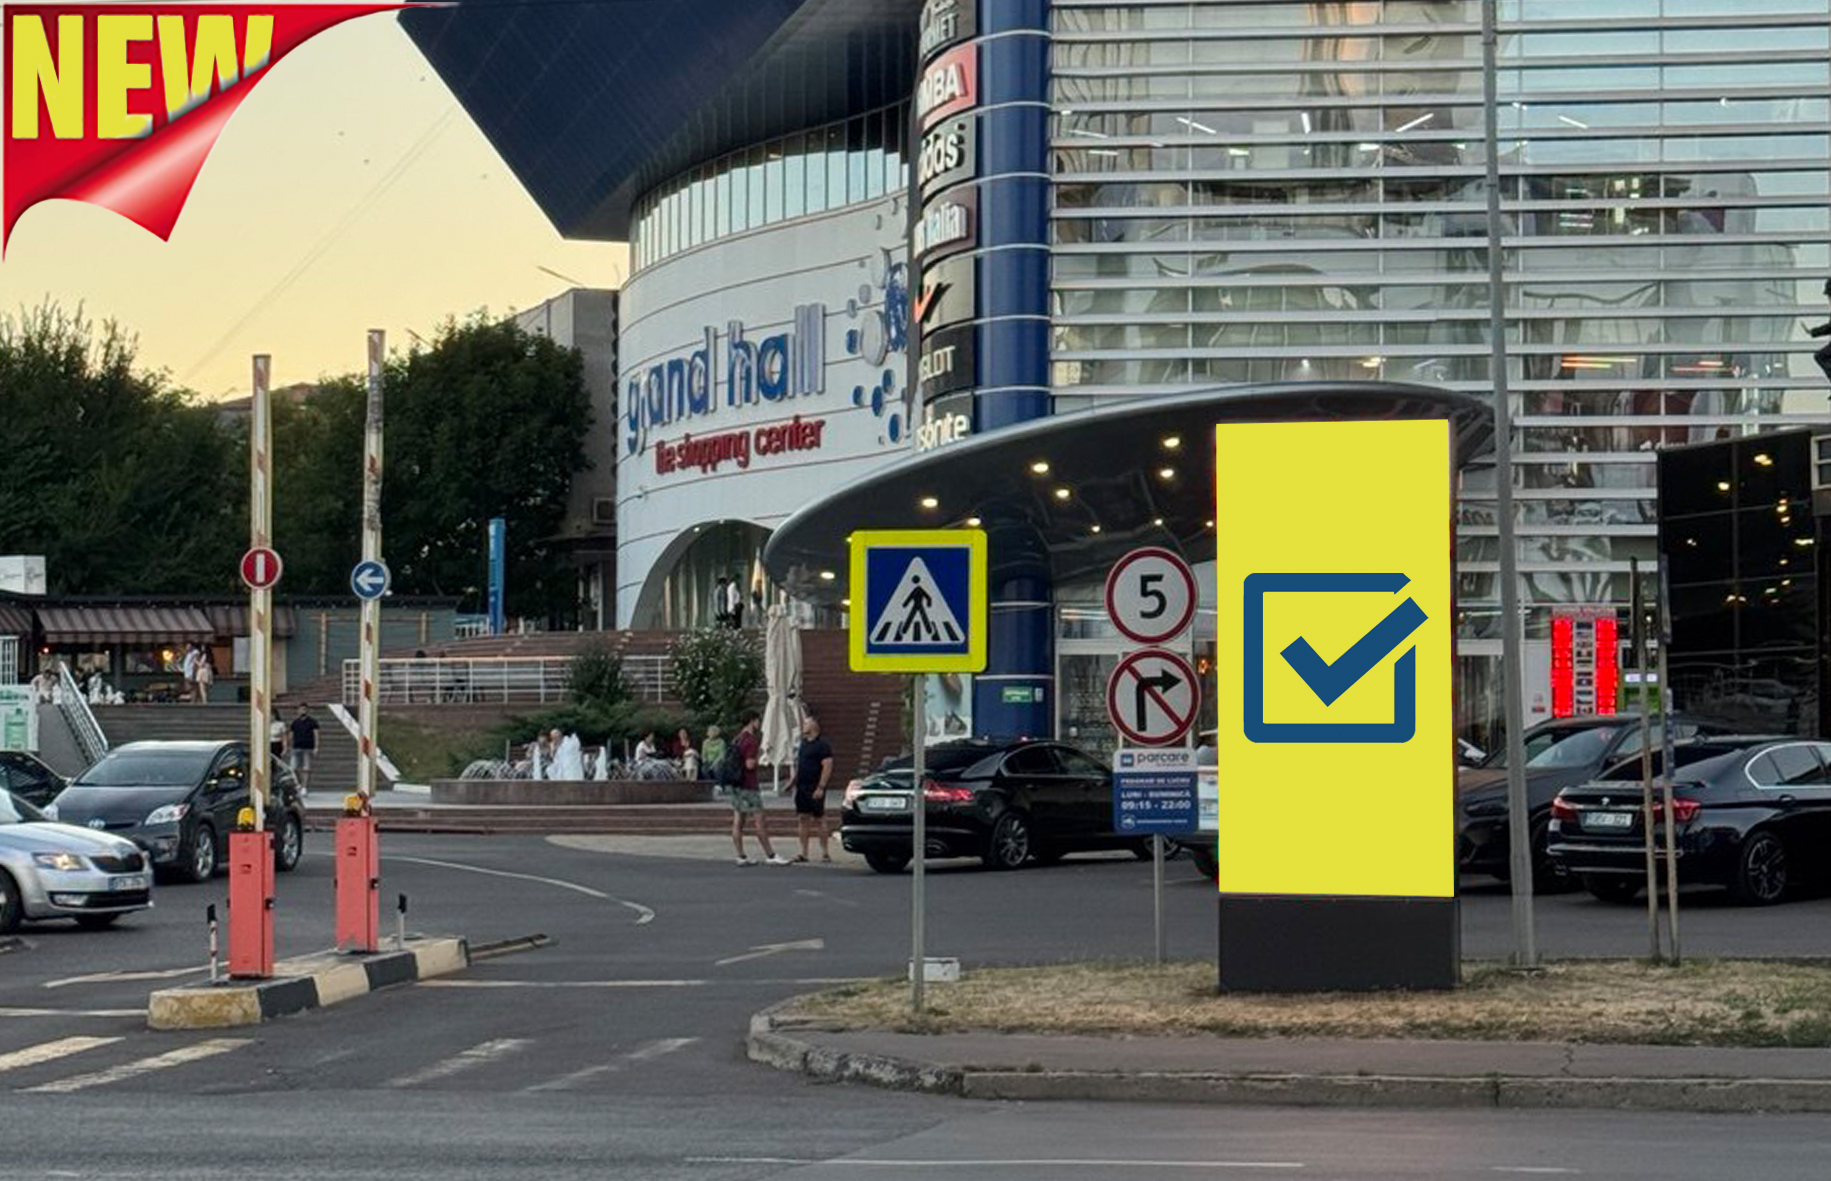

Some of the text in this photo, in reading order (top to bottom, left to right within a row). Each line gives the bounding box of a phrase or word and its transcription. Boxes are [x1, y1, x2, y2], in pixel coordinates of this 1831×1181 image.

[627, 303, 826, 458] grand hall
[677, 432, 750, 475] shopping
[754, 415, 826, 456] center
[1139, 574, 1168, 620] 5
[1137, 753, 1190, 765] parcare
